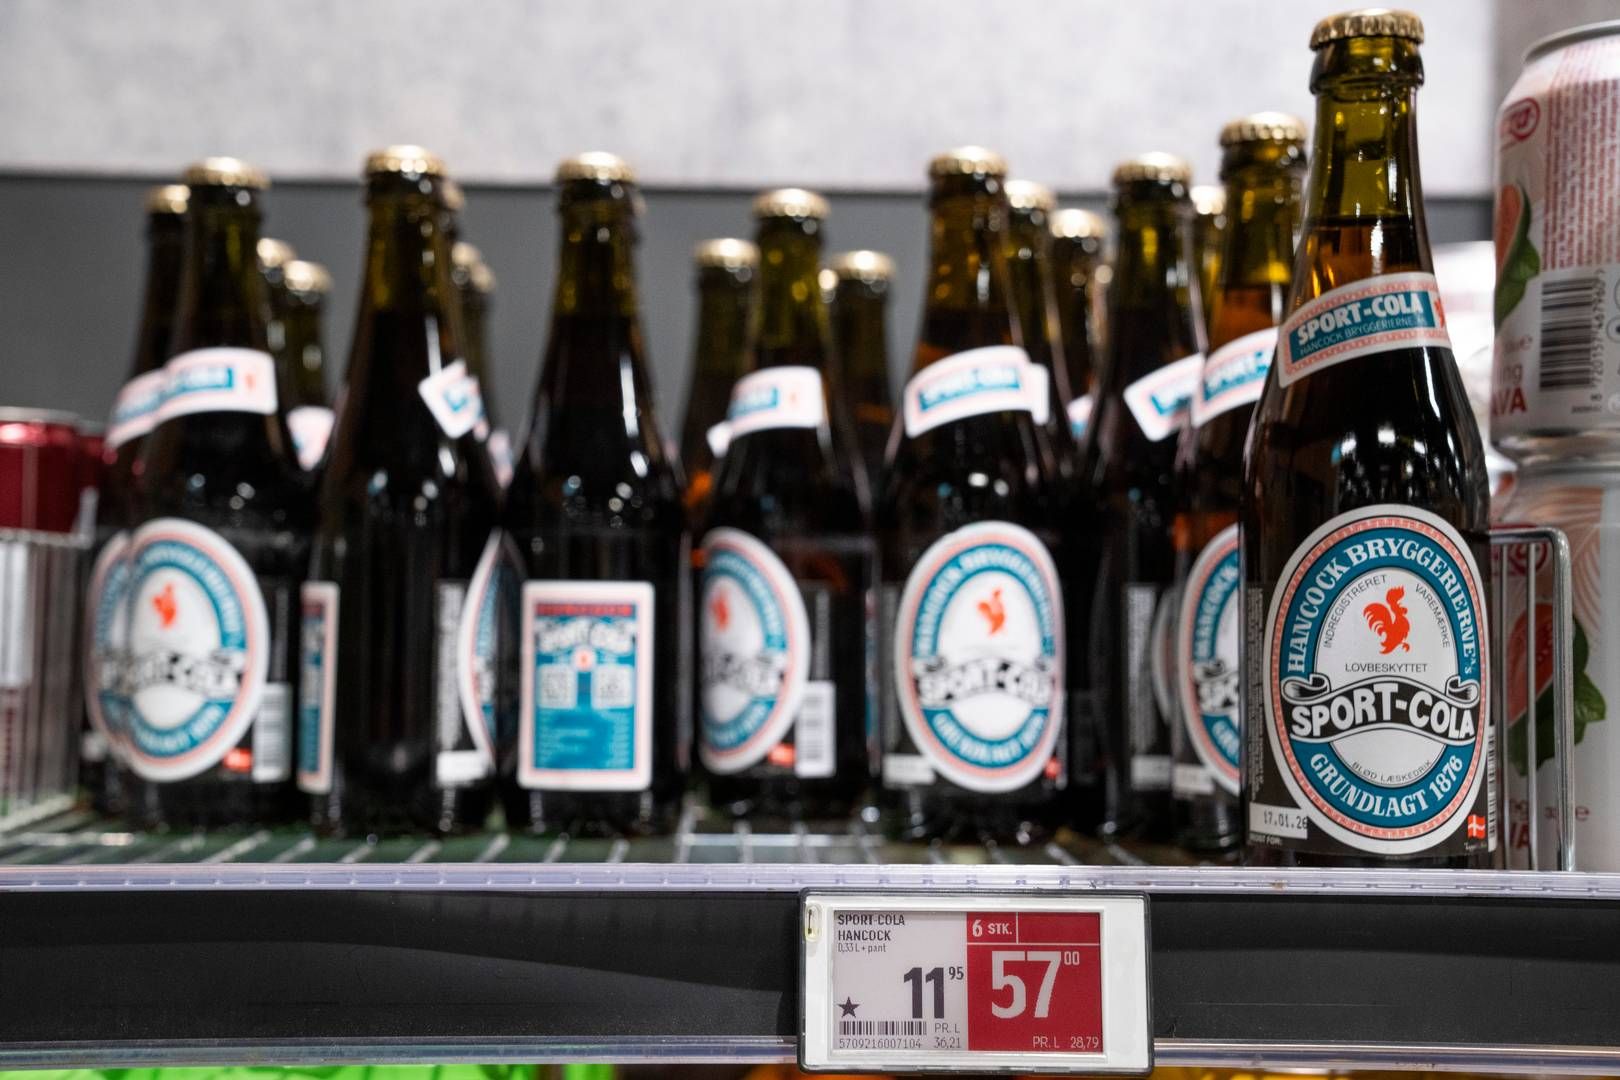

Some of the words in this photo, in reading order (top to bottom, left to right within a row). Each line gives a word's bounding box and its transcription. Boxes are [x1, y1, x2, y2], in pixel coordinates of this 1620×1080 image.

[1297, 292, 1424, 345] SPORT-COLA
[1287, 556, 1350, 673] HANCOCK
[1323, 574, 1388, 649] INDREGISTRERET
[1414, 582, 1451, 648] VAREMÆRKE
[1344, 662, 1428, 673] LOVBESKYTTET
[1291, 682, 1476, 738] SPORT-COLA
[1310, 753, 1426, 818] GRUNDLAGT
[1429, 754, 1463, 801] 1876
[837, 914, 905, 926] SPORT-COLA
[972, 919, 983, 937] 6
[987, 922, 1013, 935] STK.
[837, 930, 892, 941] HANCOCK
[837, 943, 854, 953] 0,33
[867, 943, 887, 954] pant
[903, 967, 945, 1019] 11
[948, 966, 964, 980] 95
[991, 950, 1062, 1019] 57
[1063, 951, 1080, 966] 00
[934, 1022, 951, 1034] PR.
[954, 1022, 961, 1033] L
[839, 1038, 922, 1049] 5709216007104
[933, 1037, 961, 1049] 36,21
[1032, 1035, 1051, 1048] PR.
[1053, 1036, 1060, 1049] L
[1070, 1036, 1100, 1050] 28,79
